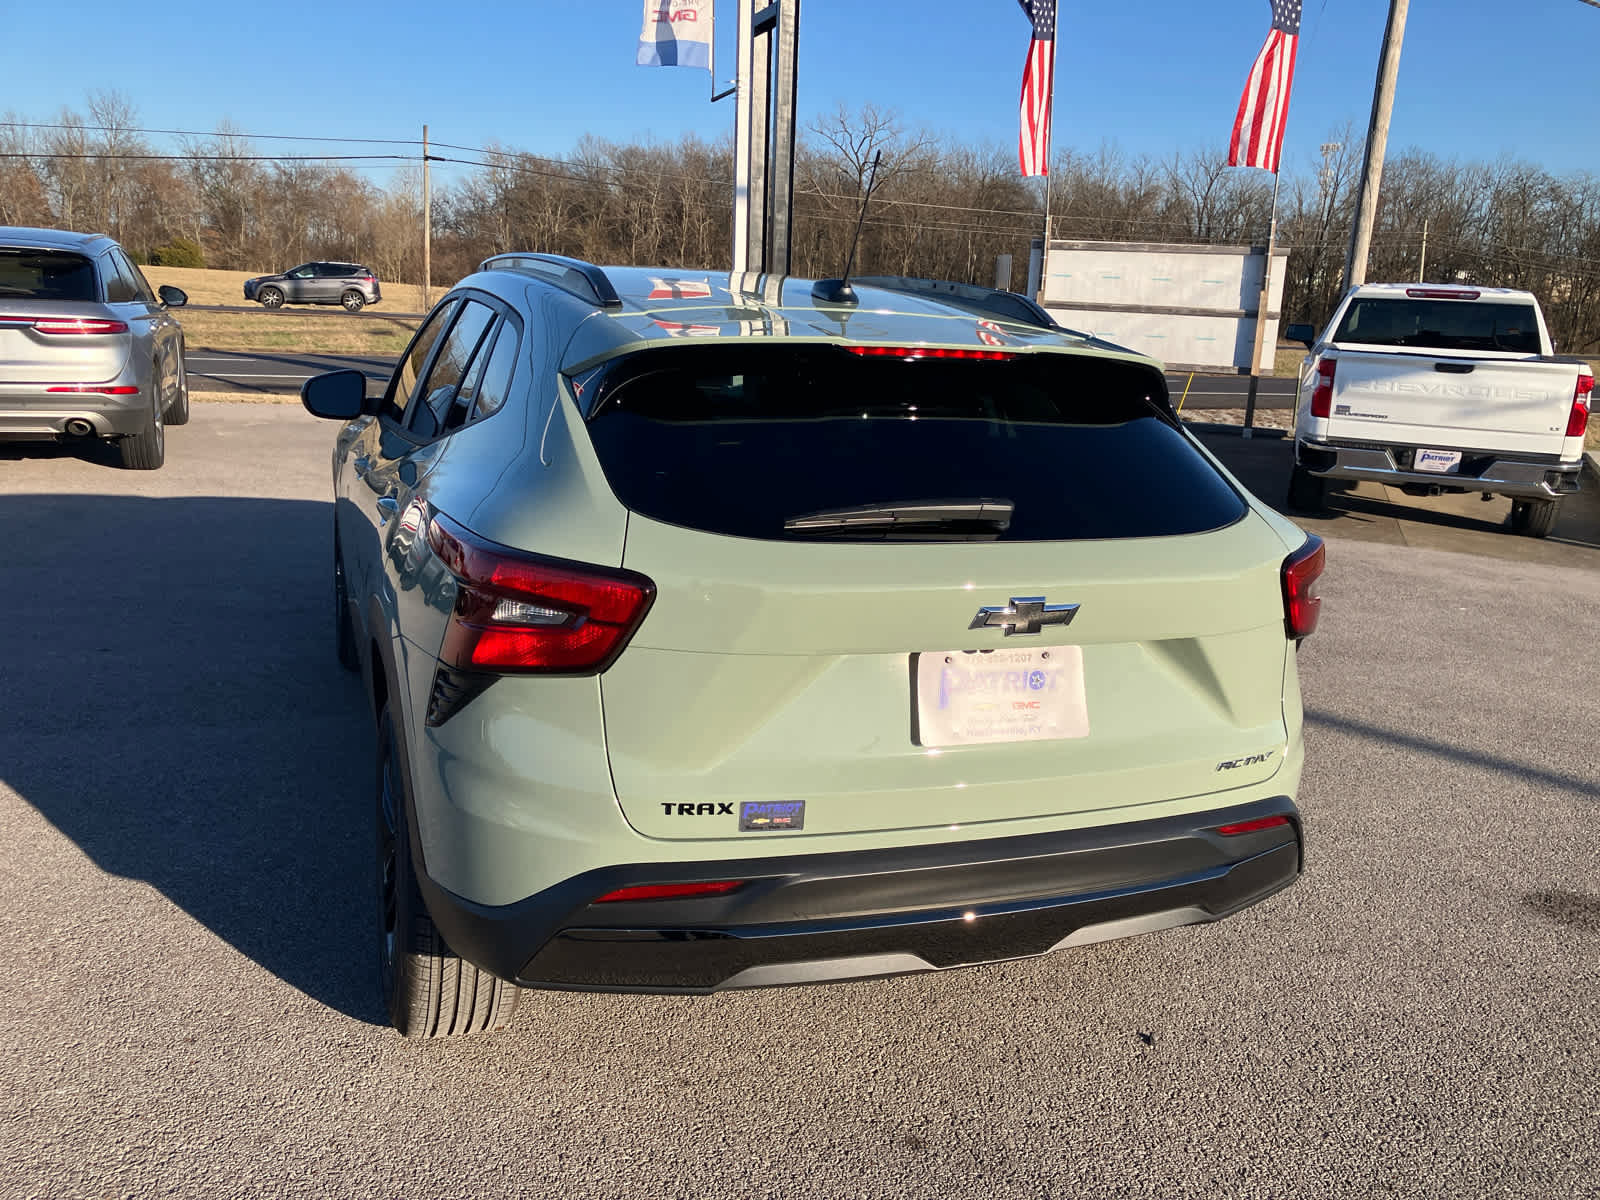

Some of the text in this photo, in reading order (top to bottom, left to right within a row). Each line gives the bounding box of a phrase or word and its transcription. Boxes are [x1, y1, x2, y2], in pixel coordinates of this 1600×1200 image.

[1347, 380, 1560, 401] CHEVROLET
[1420, 453, 1456, 463] PATRIOT
[1012, 701, 1041, 710] GMC
[661, 801, 735, 816] TRAX
[743, 802, 803, 819] PATRIOT
